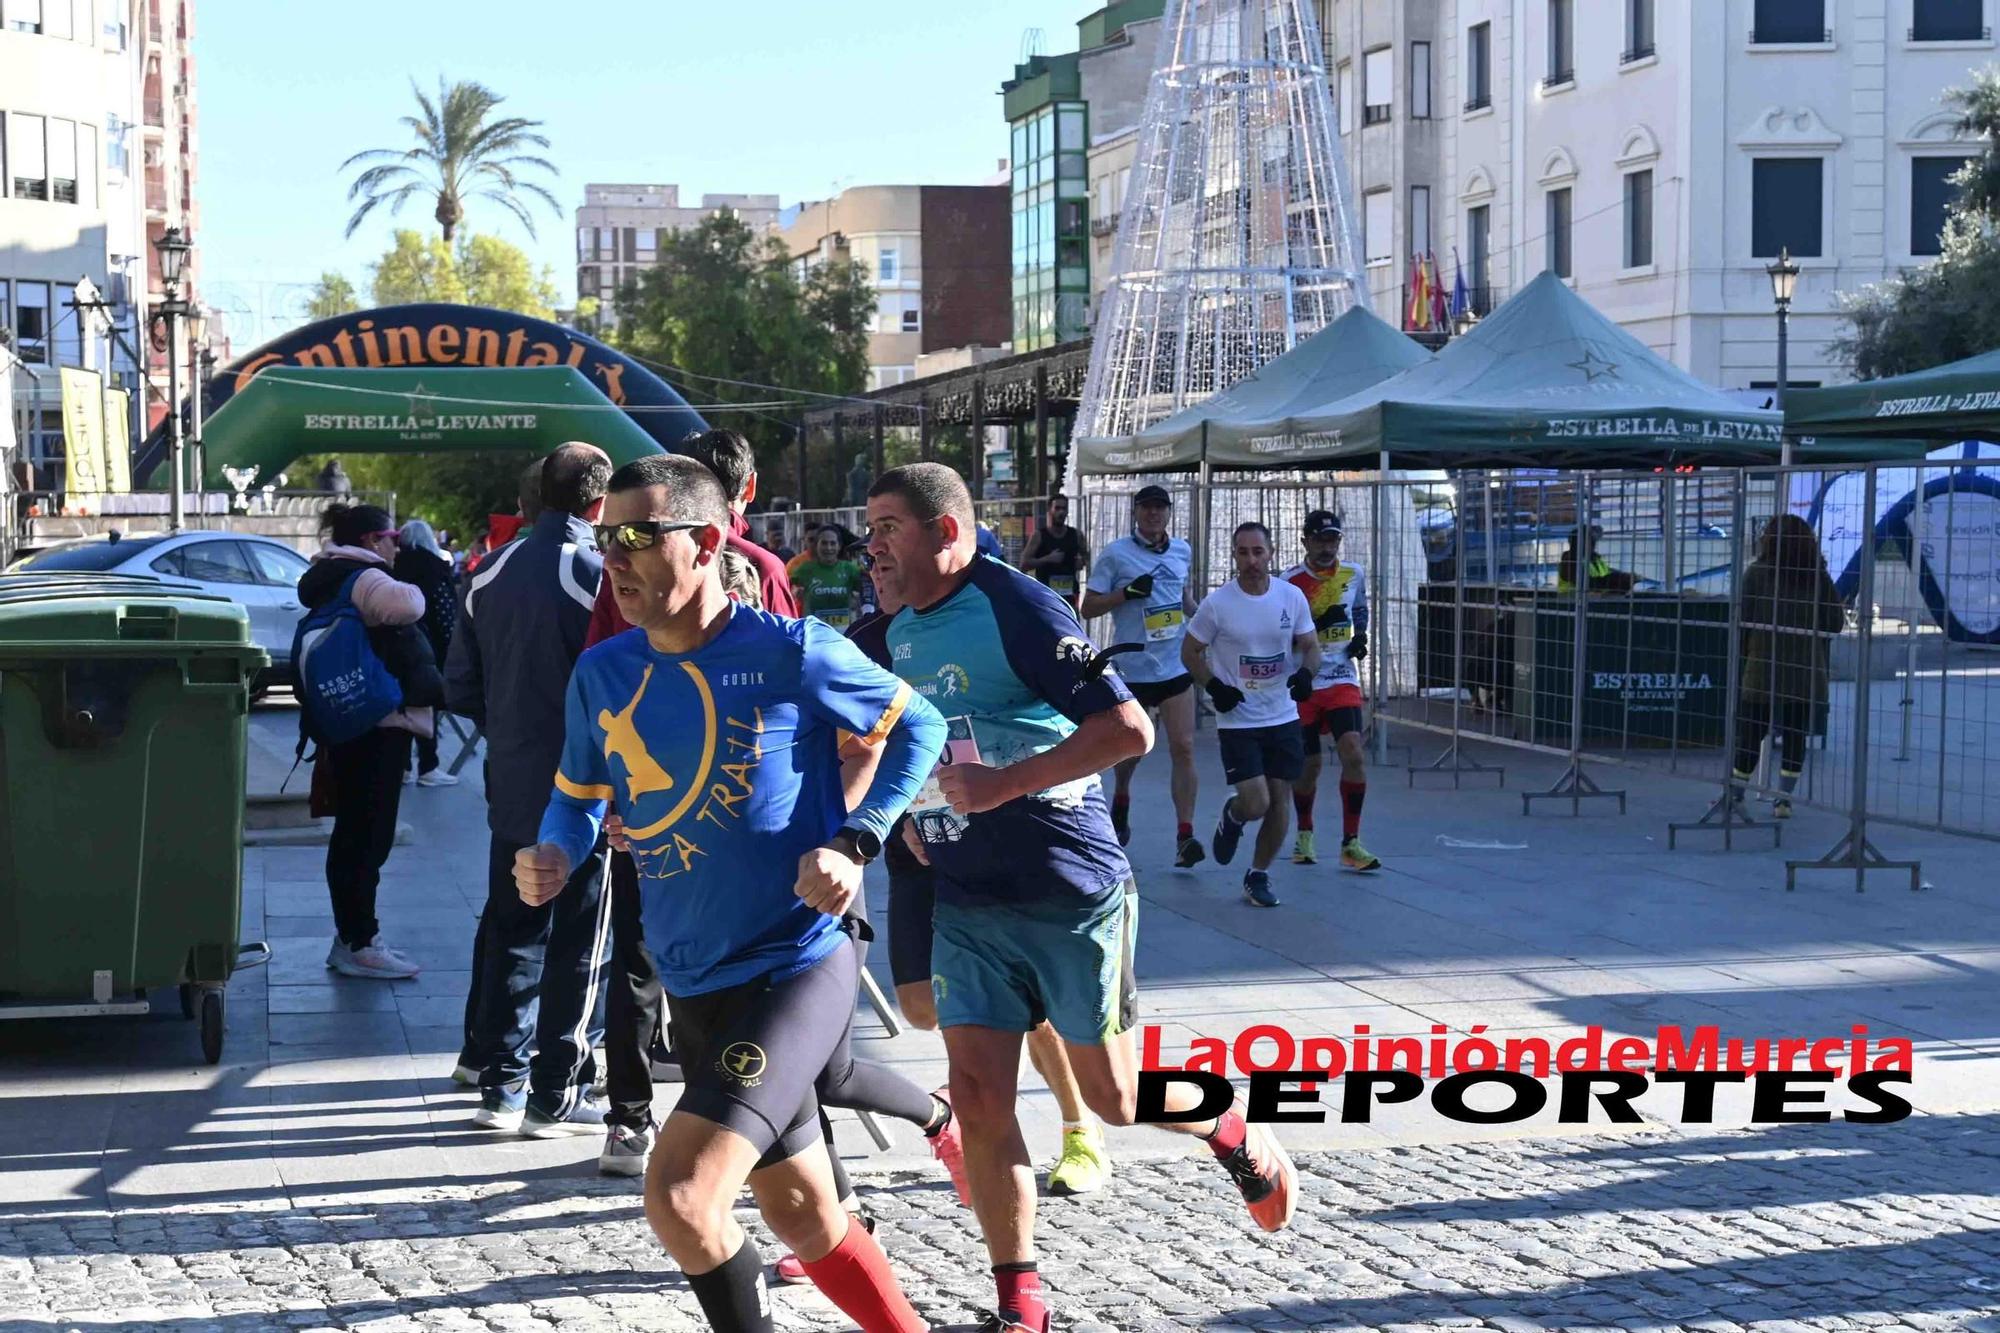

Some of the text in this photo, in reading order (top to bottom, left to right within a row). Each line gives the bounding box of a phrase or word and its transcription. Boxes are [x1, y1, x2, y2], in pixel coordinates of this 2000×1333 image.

[1876, 395, 1951, 416] ESTRELLA
[304, 415, 418, 429] ESTRELLA
[437, 415, 537, 429] LEVANTE
[1547, 418, 1816, 445] ESTRELLA DE LEVANE
[1164, 612, 1172, 623] 3
[722, 671, 765, 687] GOBIK
[1593, 673, 1713, 689] ESTRELLA
